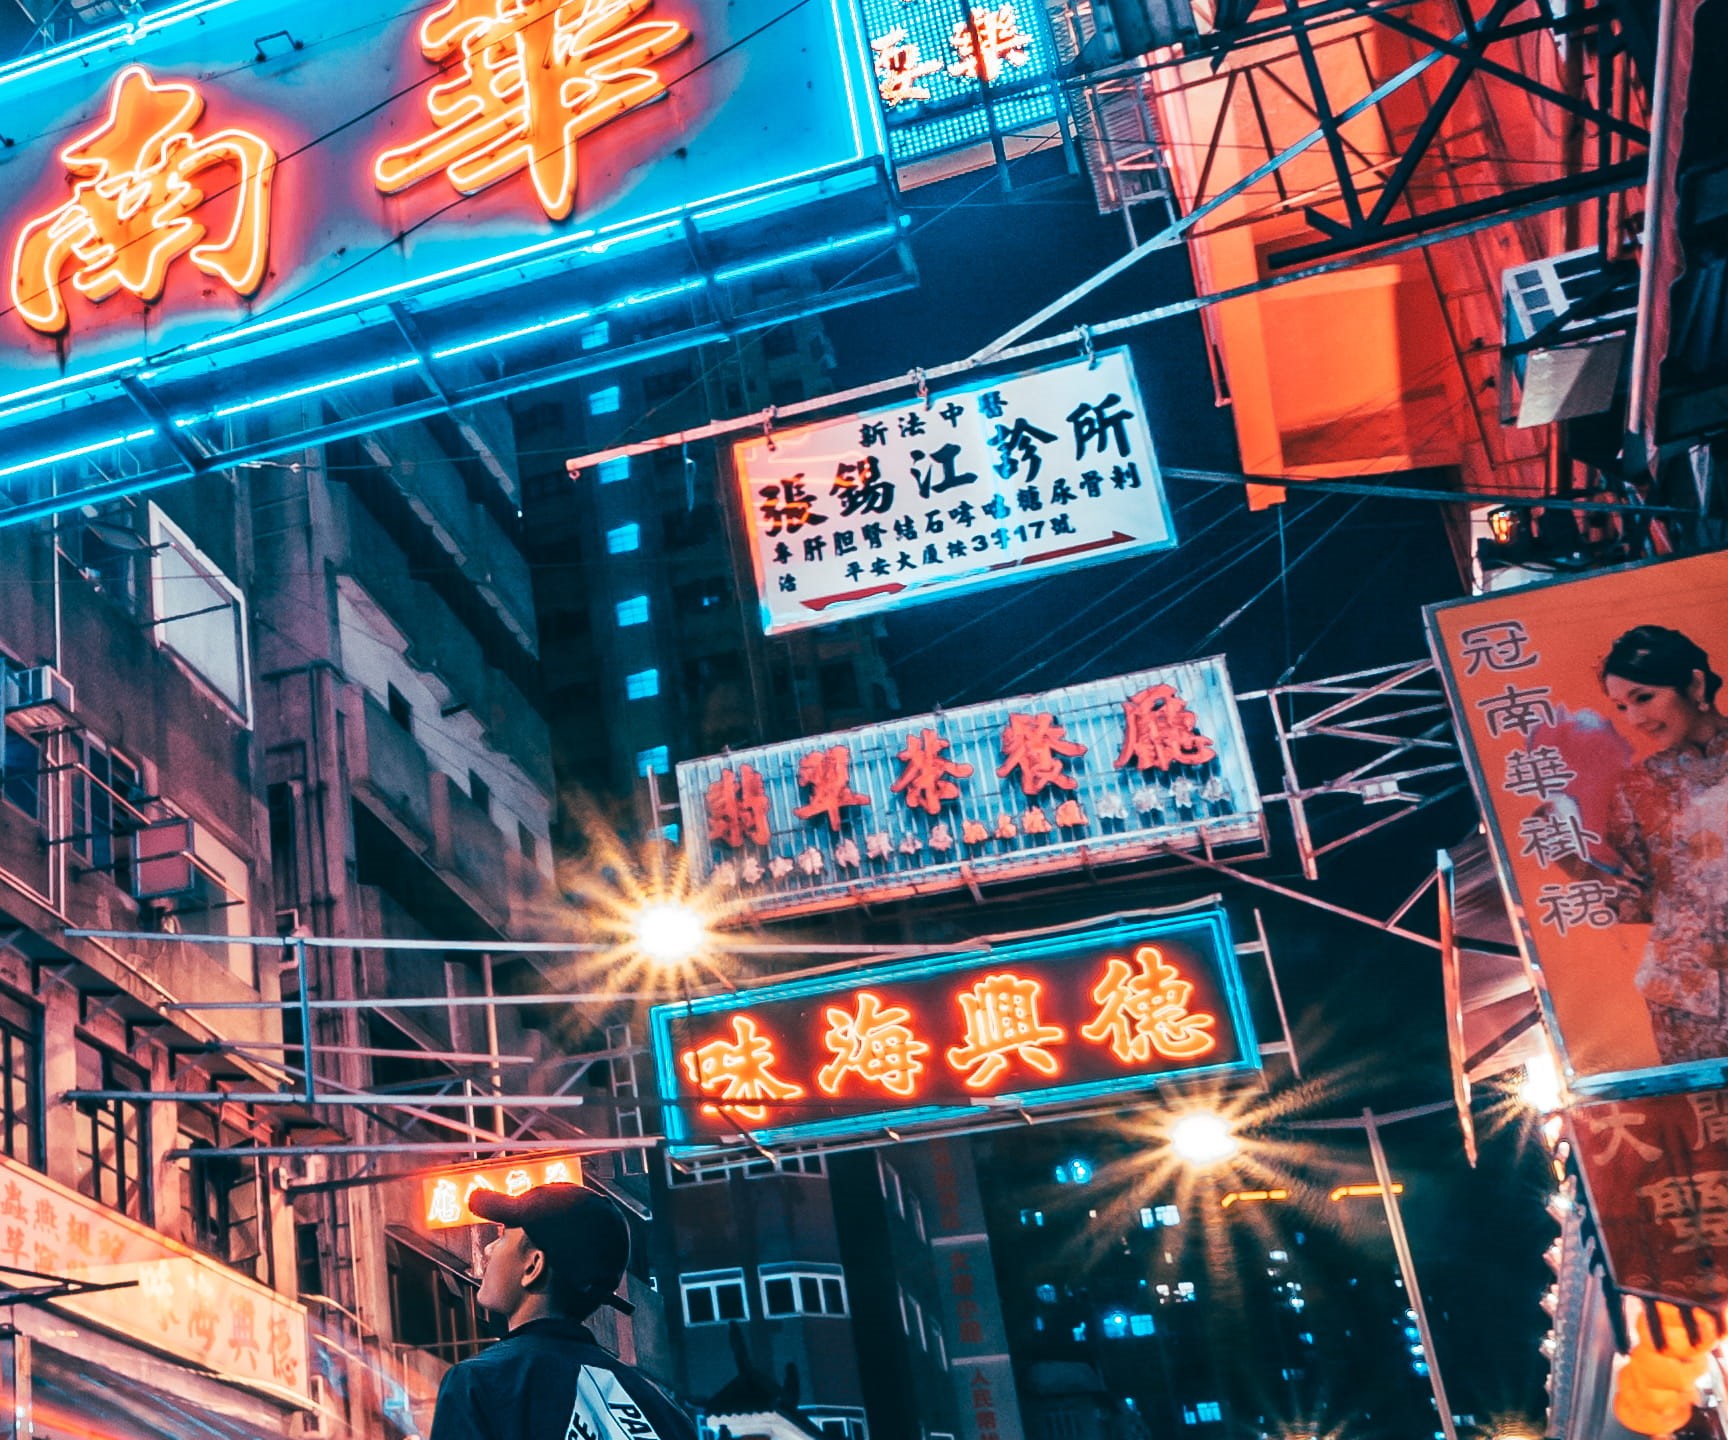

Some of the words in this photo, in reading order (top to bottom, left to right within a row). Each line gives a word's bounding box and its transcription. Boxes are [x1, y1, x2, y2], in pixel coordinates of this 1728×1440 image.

[759, 394, 1133, 537] 張錫江診所
[859, 391, 1009, 448] 新法中醫
[706, 683, 1218, 848] 翡翠茶餐廳
[1460, 620, 1619, 939] 冠南華褂裙
